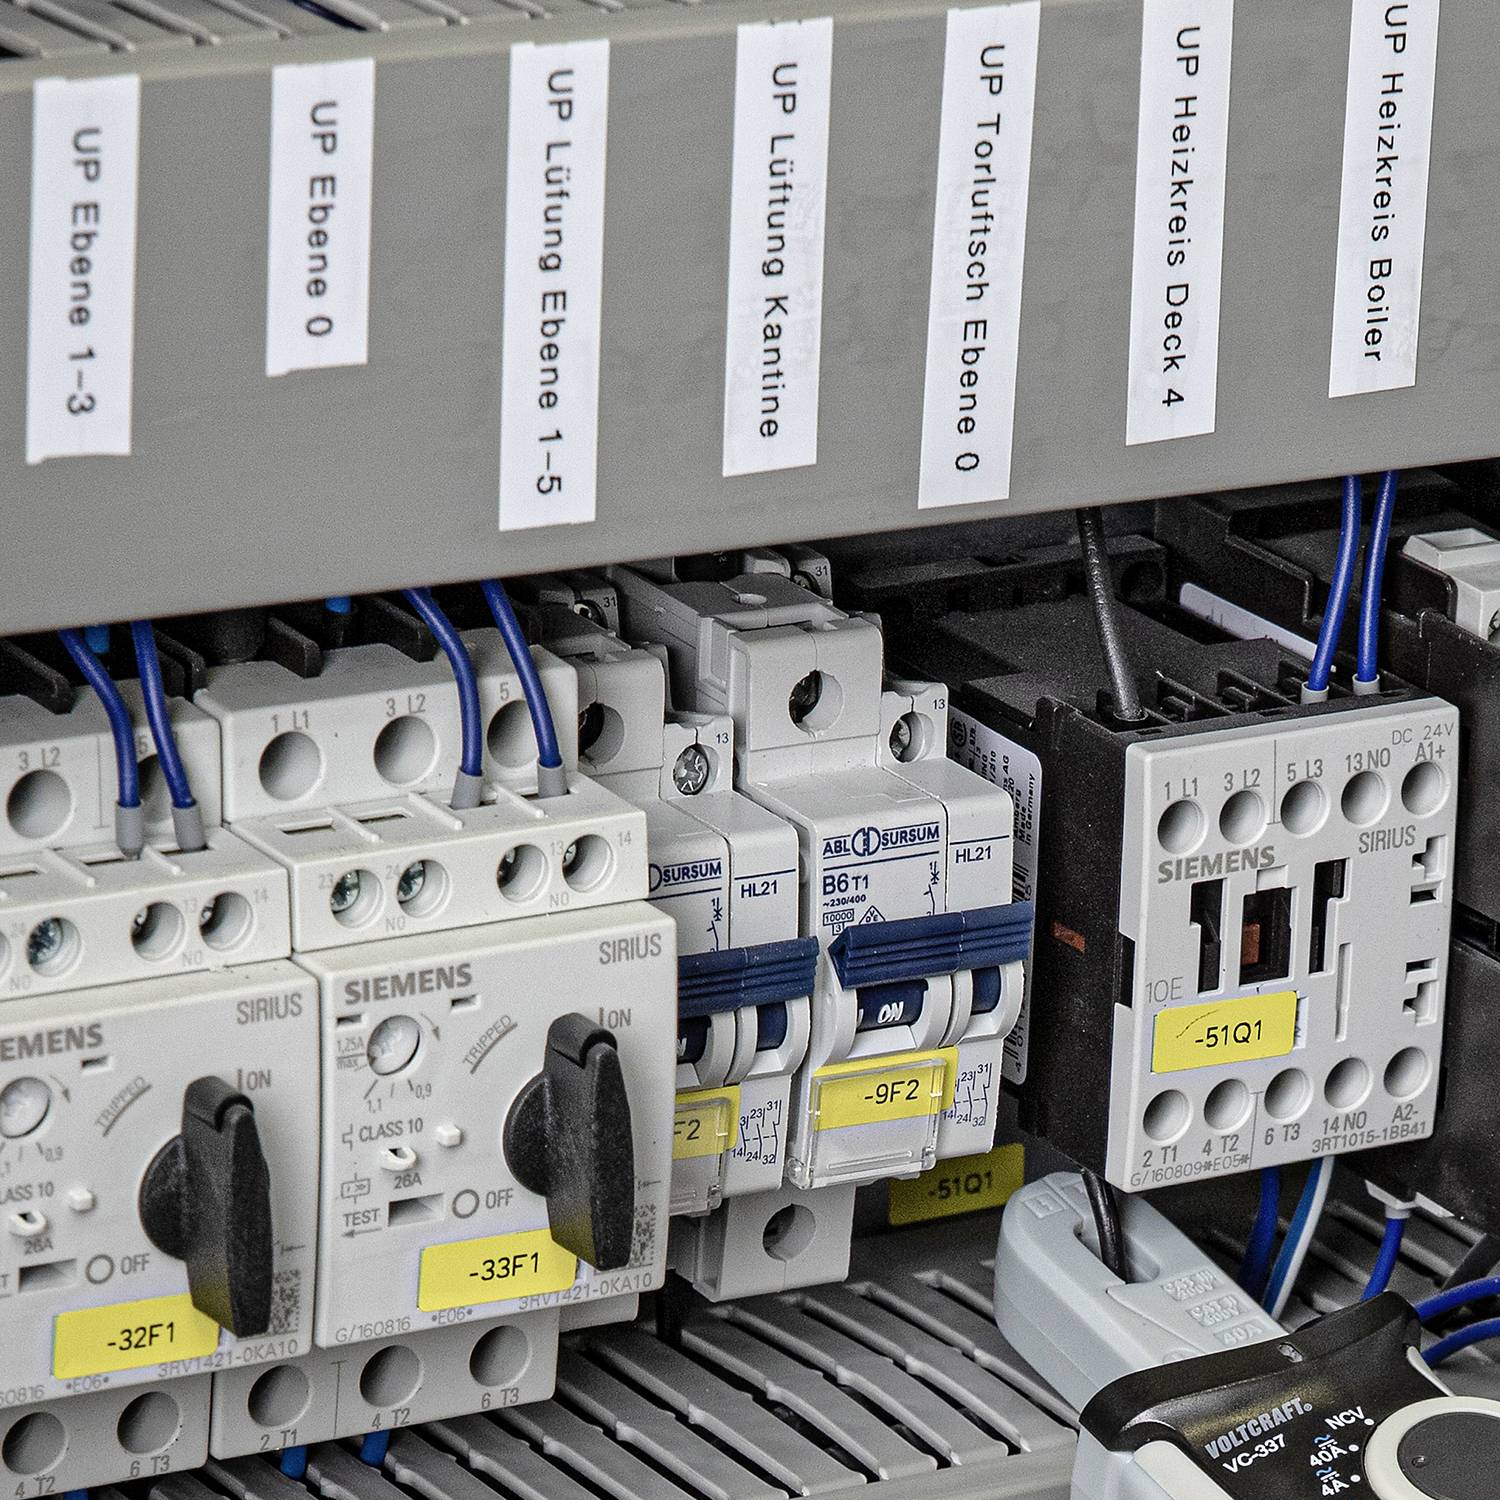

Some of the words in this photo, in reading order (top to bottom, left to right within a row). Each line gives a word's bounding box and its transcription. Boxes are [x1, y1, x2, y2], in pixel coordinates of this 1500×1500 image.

[1384, 4, 1409, 54] UP
[1175, 26, 1201, 76] UP
[979, 44, 1005, 96] UP
[546, 69, 574, 122] UP
[772, 63, 798, 115] UP
[310, 100, 339, 156] UP
[70, 128, 101, 182] UP
[1370, 73, 1405, 242] Heizkreis
[1166, 96, 1198, 267] Heizkreis
[539, 142, 571, 272] Lüfung
[763, 135, 795, 277] Lüftung
[964, 113, 1002, 302] Torluftsch
[306, 175, 338, 300] Ebene
[68, 201, 100, 328] Ebene
[1363, 258, 1393, 362] Boiler
[304, 314, 334, 338] 0
[1163, 283, 1190, 373] Deck
[538, 291, 567, 410] Ebene
[65, 346, 97, 415] 1-3
[759, 294, 790, 438] Kantine
[956, 319, 988, 436] Ebene
[1161, 388, 1185, 407] 4
[537, 429, 563, 495] 1-5
[955, 452, 980, 472] 0
[1391, 729, 1413, 744] DC
[1423, 723, 1455, 740] 24V
[1306, 760, 1324, 778] L3
[1345, 754, 1362, 773] 13
[1366, 749, 1391, 768] NO
[1414, 742, 1446, 762] A1+
[1182, 779, 1199, 797] L1
[1243, 769, 1261, 788] L2
[822, 838, 851, 856] ABL
[881, 824, 940, 845] SURSUM
[1358, 826, 1416, 853] SIRIUS
[955, 846, 992, 864] HL21
[1158, 846, 1275, 884] SIEMENS
[662, 861, 722, 882] SURSUM
[822, 873, 850, 894] B6
[740, 881, 777, 899] HL21
[825, 911, 852, 922] 10000
[599, 934, 663, 965] SIRIUS
[343, 963, 473, 1005] SIEMENS
[1146, 977, 1184, 1003] 10E
[236, 993, 302, 1024] SIRIUS
[608, 1007, 632, 1029] ON
[878, 1001, 904, 1022] ON
[463, 1014, 514, 1066] TRIPPED
[1194, 1020, 1263, 1049] -51Q1
[246, 1068, 272, 1090] ON
[865, 1079, 920, 1105] -9F2
[359, 1121, 403, 1142] CLASS
[408, 1118, 423, 1133] 10
[485, 1189, 514, 1209] OFF
[927, 1171, 993, 1199] -51Q1
[342, 1209, 380, 1227] TEST
[120, 1254, 150, 1275] OFF
[468, 1253, 541, 1281] -33F1
[106, 1323, 176, 1351] -32F1
[335, 1315, 411, 1343] G/160816
[1325, 1407, 1364, 1430] NCV
[1222, 1434, 1286, 1474] VC-337
[1310, 1445, 1347, 1467] 40A
[1322, 1479, 1349, 1496] 4A
